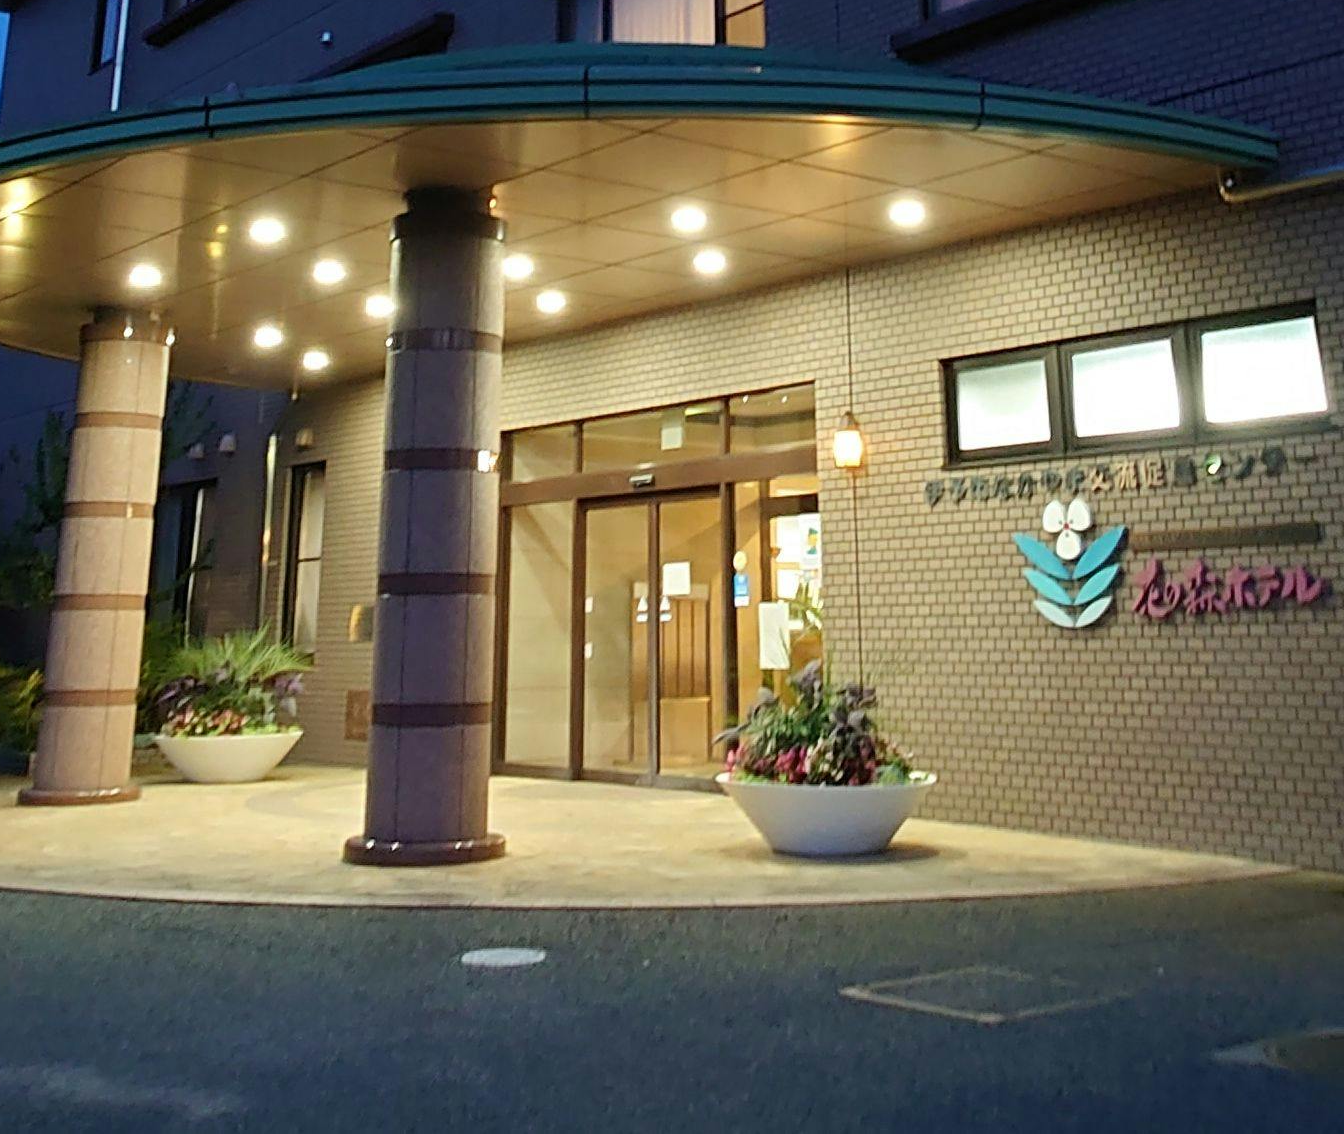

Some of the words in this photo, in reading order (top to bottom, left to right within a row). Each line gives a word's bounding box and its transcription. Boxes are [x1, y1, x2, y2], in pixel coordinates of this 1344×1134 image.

[1131, 556, 1323, 618] 花の森ホテル
